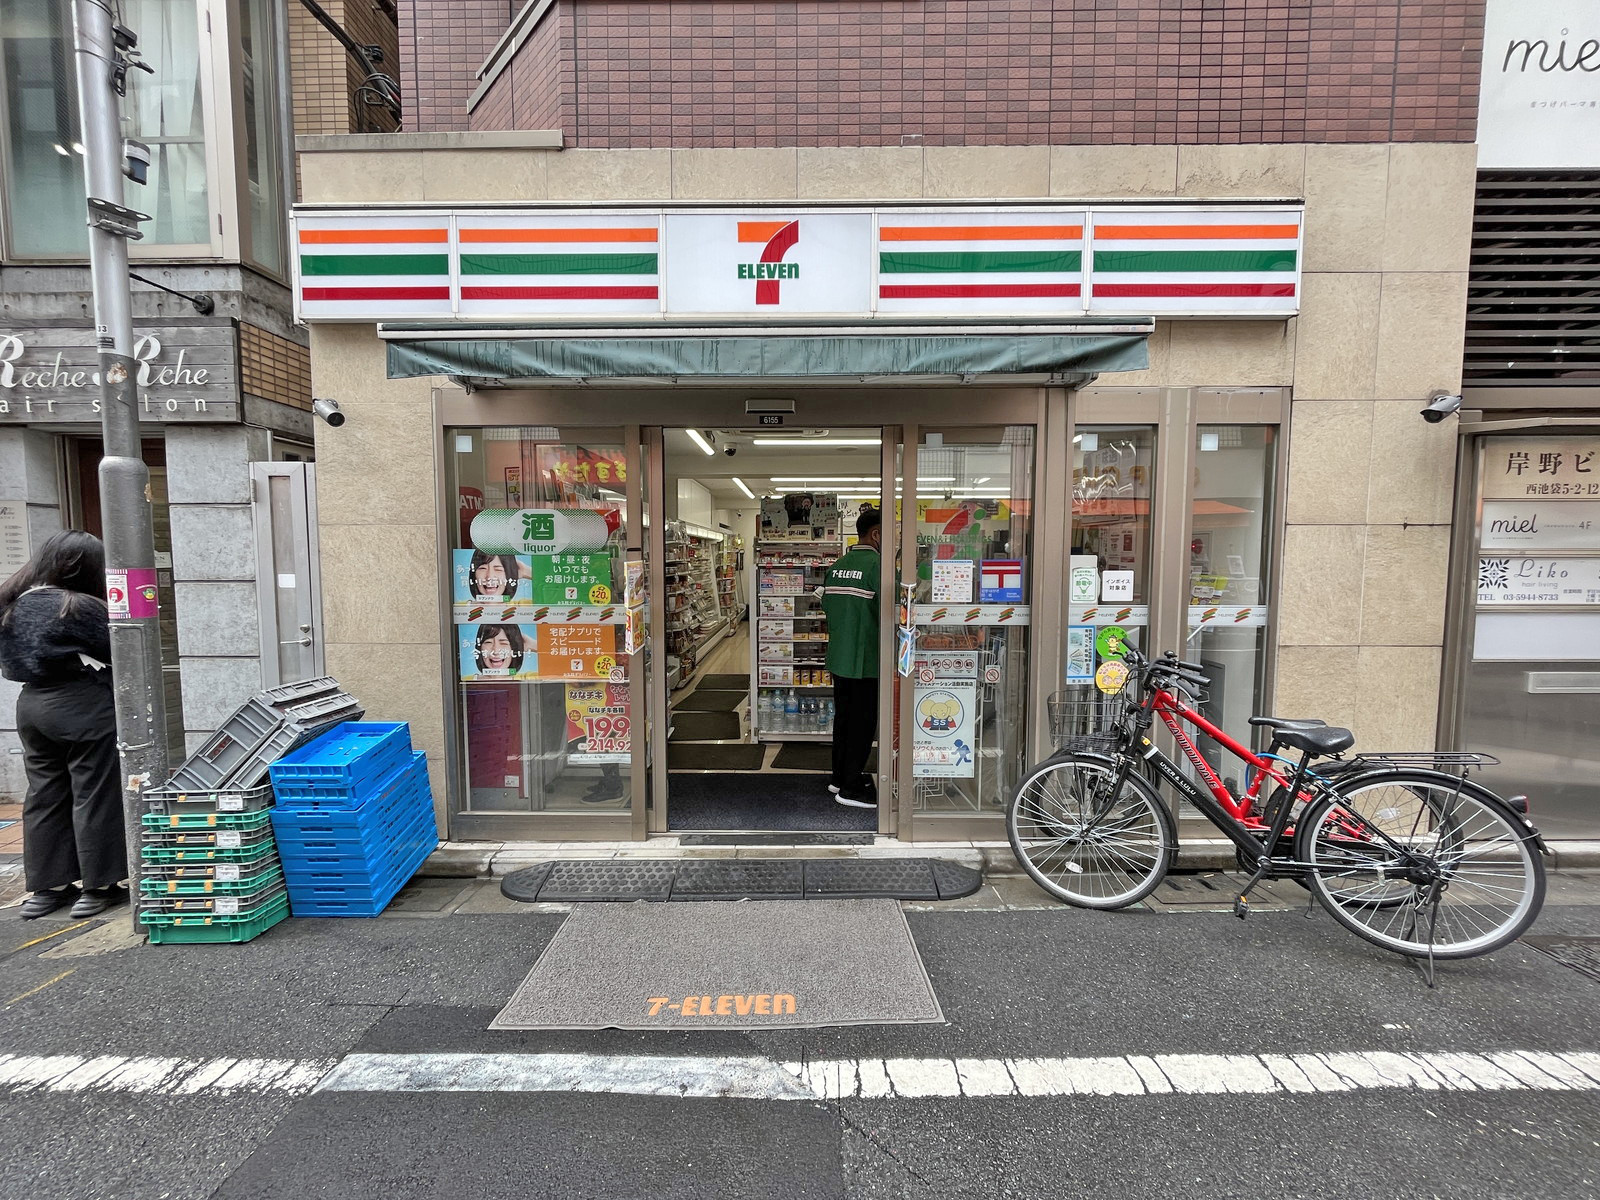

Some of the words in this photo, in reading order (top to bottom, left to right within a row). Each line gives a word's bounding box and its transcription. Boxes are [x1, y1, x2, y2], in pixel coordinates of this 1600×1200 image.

[0, 396, 57, 413] air
[92, 393, 208, 413] slon
[763, 416, 779, 424] 6155
[521, 512, 555, 541] 酒
[1490, 513, 1539, 534] miel
[1578, 520, 1592, 529] 4F
[523, 542, 556, 553] liquor
[553, 565, 589, 574] いつでも
[544, 575, 600, 584] お届けします。
[1502, 593, 1559, 601] 03-5944-8733
[549, 627, 601, 637] 宅配アプリで
[550, 647, 605, 656] お届けします。
[569, 690, 603, 700] ななチキ
